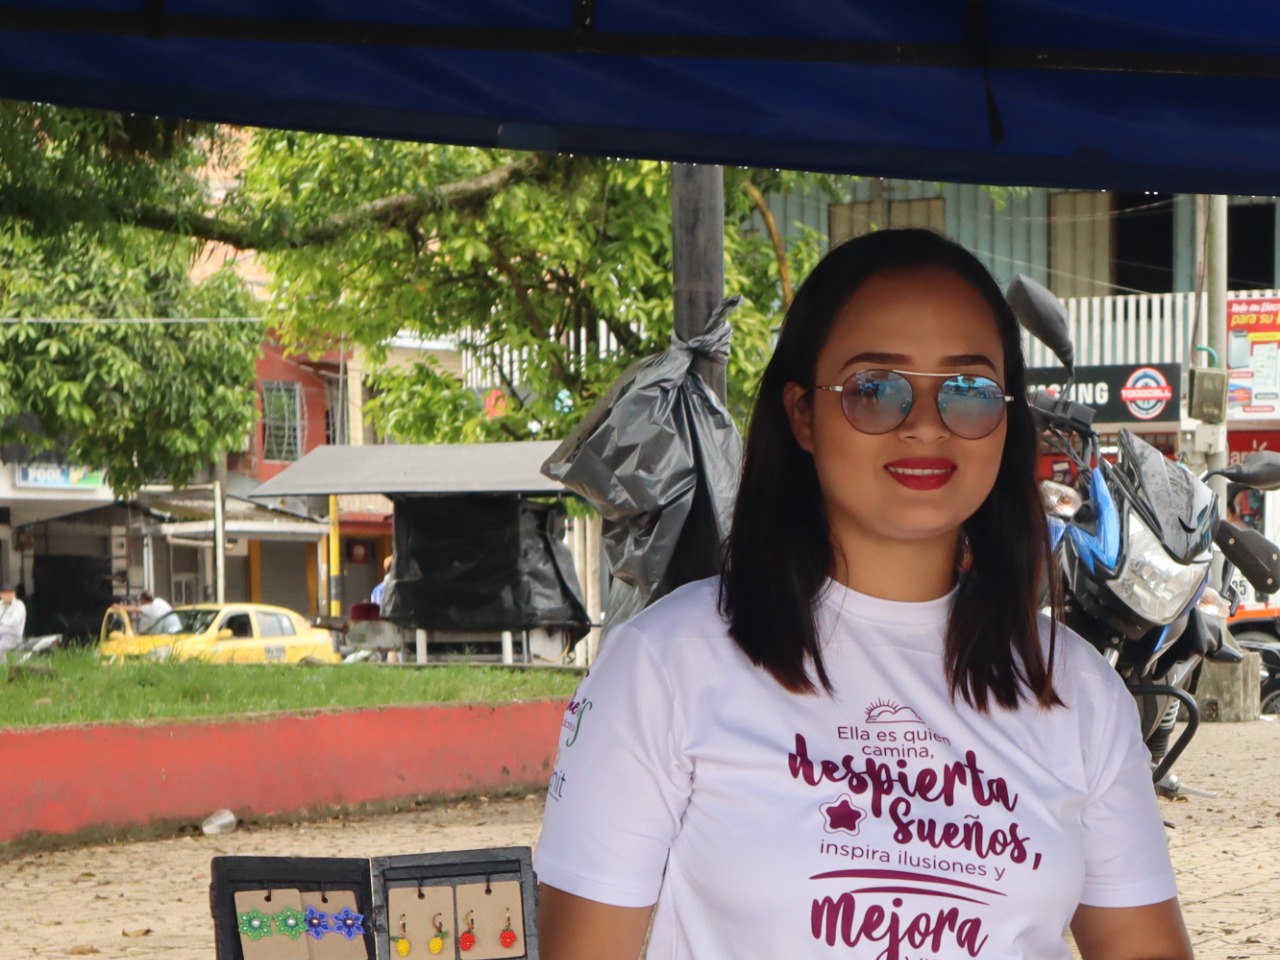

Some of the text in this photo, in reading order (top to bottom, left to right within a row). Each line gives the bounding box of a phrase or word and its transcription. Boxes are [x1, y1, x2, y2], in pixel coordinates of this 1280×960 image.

[1231, 314, 1257, 326] para
[1259, 314, 1274, 324] su
[837, 726, 952, 746] Ella es quien
[861, 745, 934, 760] camina,
[788, 733, 1019, 818] despierta
[889, 796, 1043, 871] Sueños,
[819, 839, 1007, 882] inspira ilusiones y
